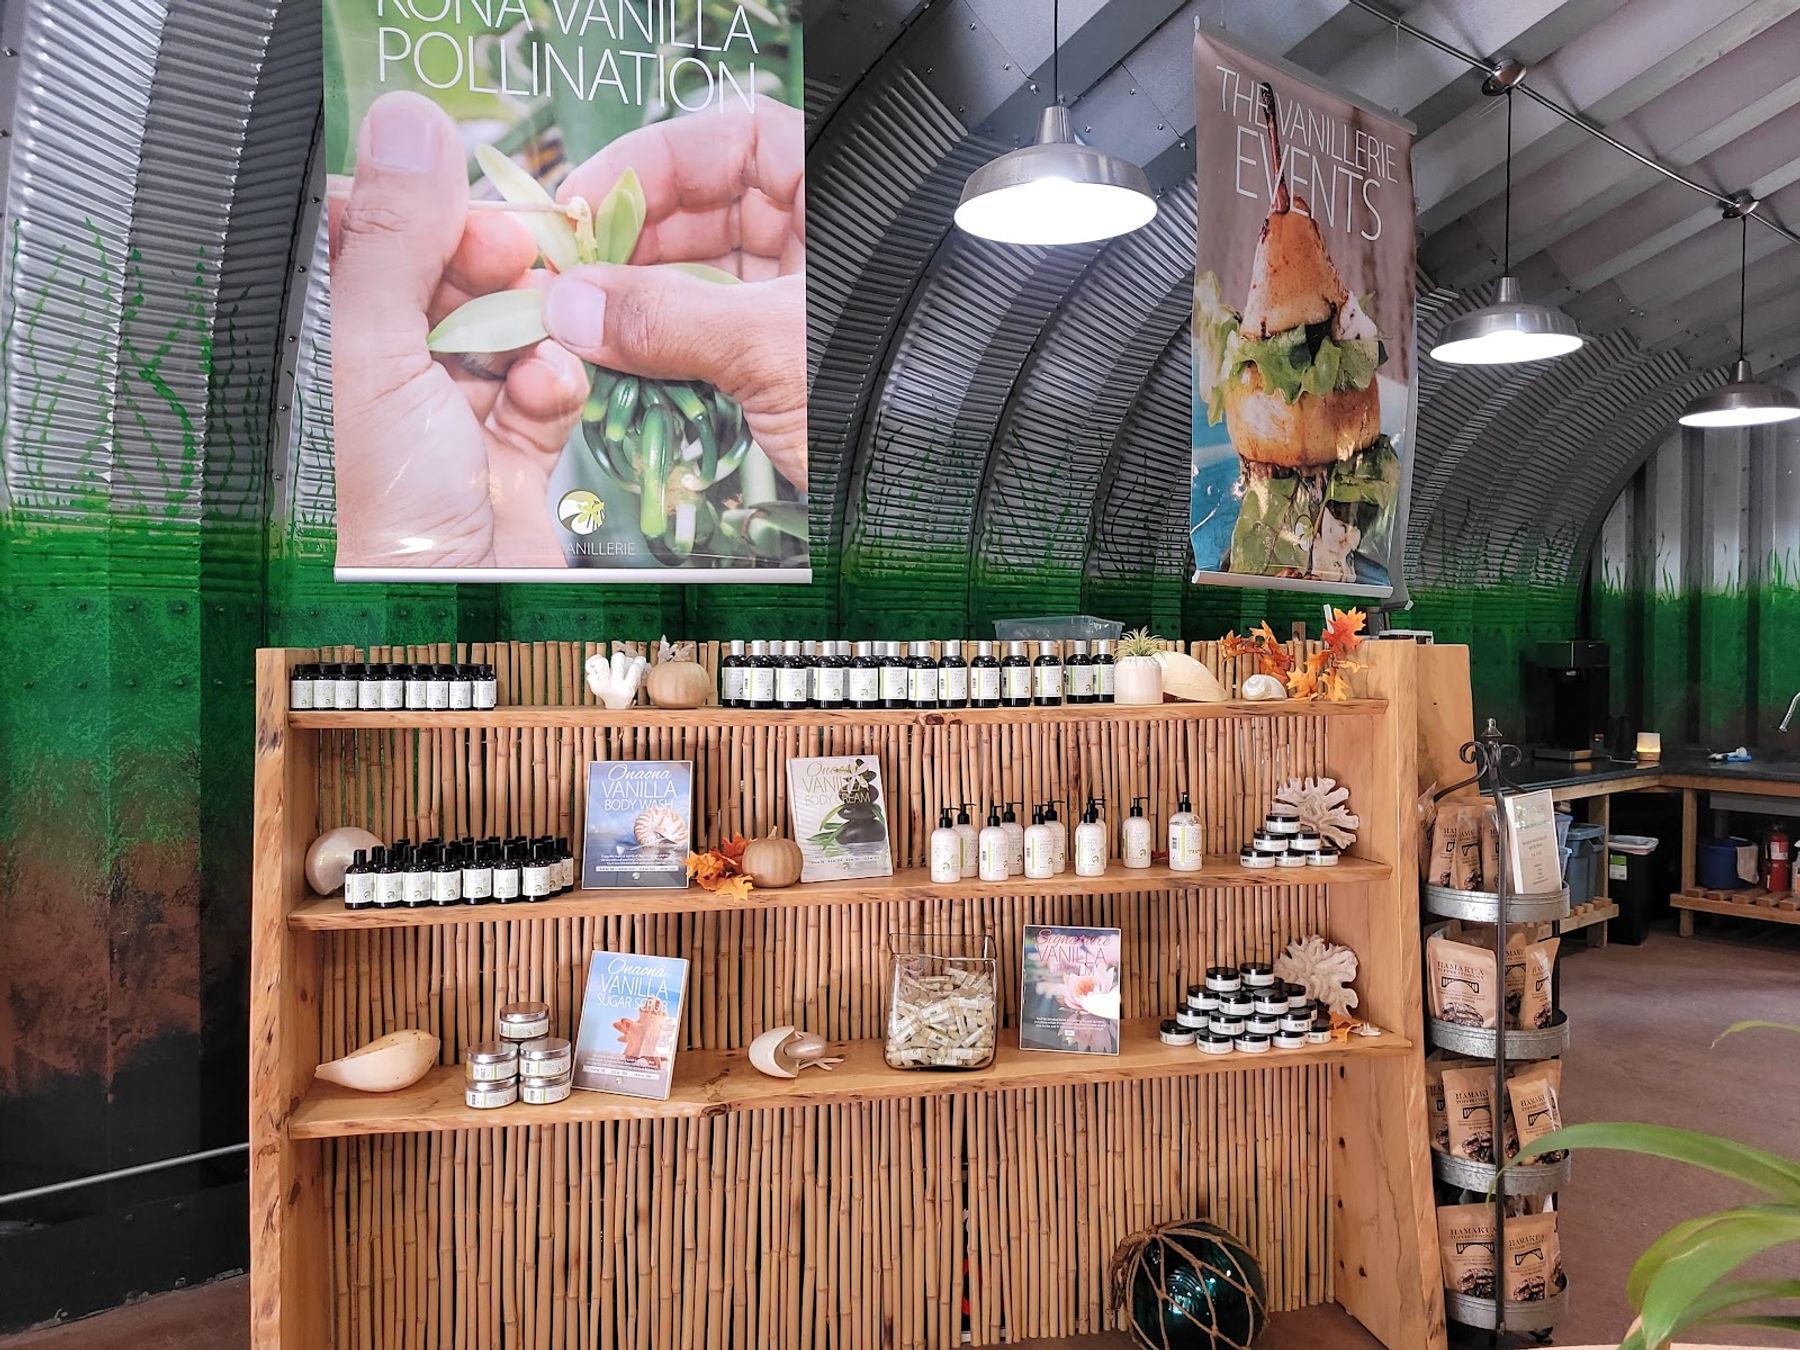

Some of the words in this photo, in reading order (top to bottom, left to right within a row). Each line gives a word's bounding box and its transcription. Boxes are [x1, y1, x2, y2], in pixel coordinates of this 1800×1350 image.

[548, 0, 760, 54] VANILLA
[377, 27, 756, 114] POLLINATION
[1216, 65, 1269, 129] THE
[1274, 92, 1399, 184] VANILLERIE
[1235, 125, 1383, 241] EVENTS
[564, 541, 637, 556] ANILLERIE
[607, 763, 672, 781] Onaona
[601, 780, 677, 799] VANILLA
[604, 798, 636, 812] BODY
[640, 799, 674, 811] WASH
[607, 957, 666, 977] Onaona
[600, 973, 668, 1000] VANILLA
[596, 993, 632, 1008] SUGAR
[634, 997, 669, 1013] SCRUB
